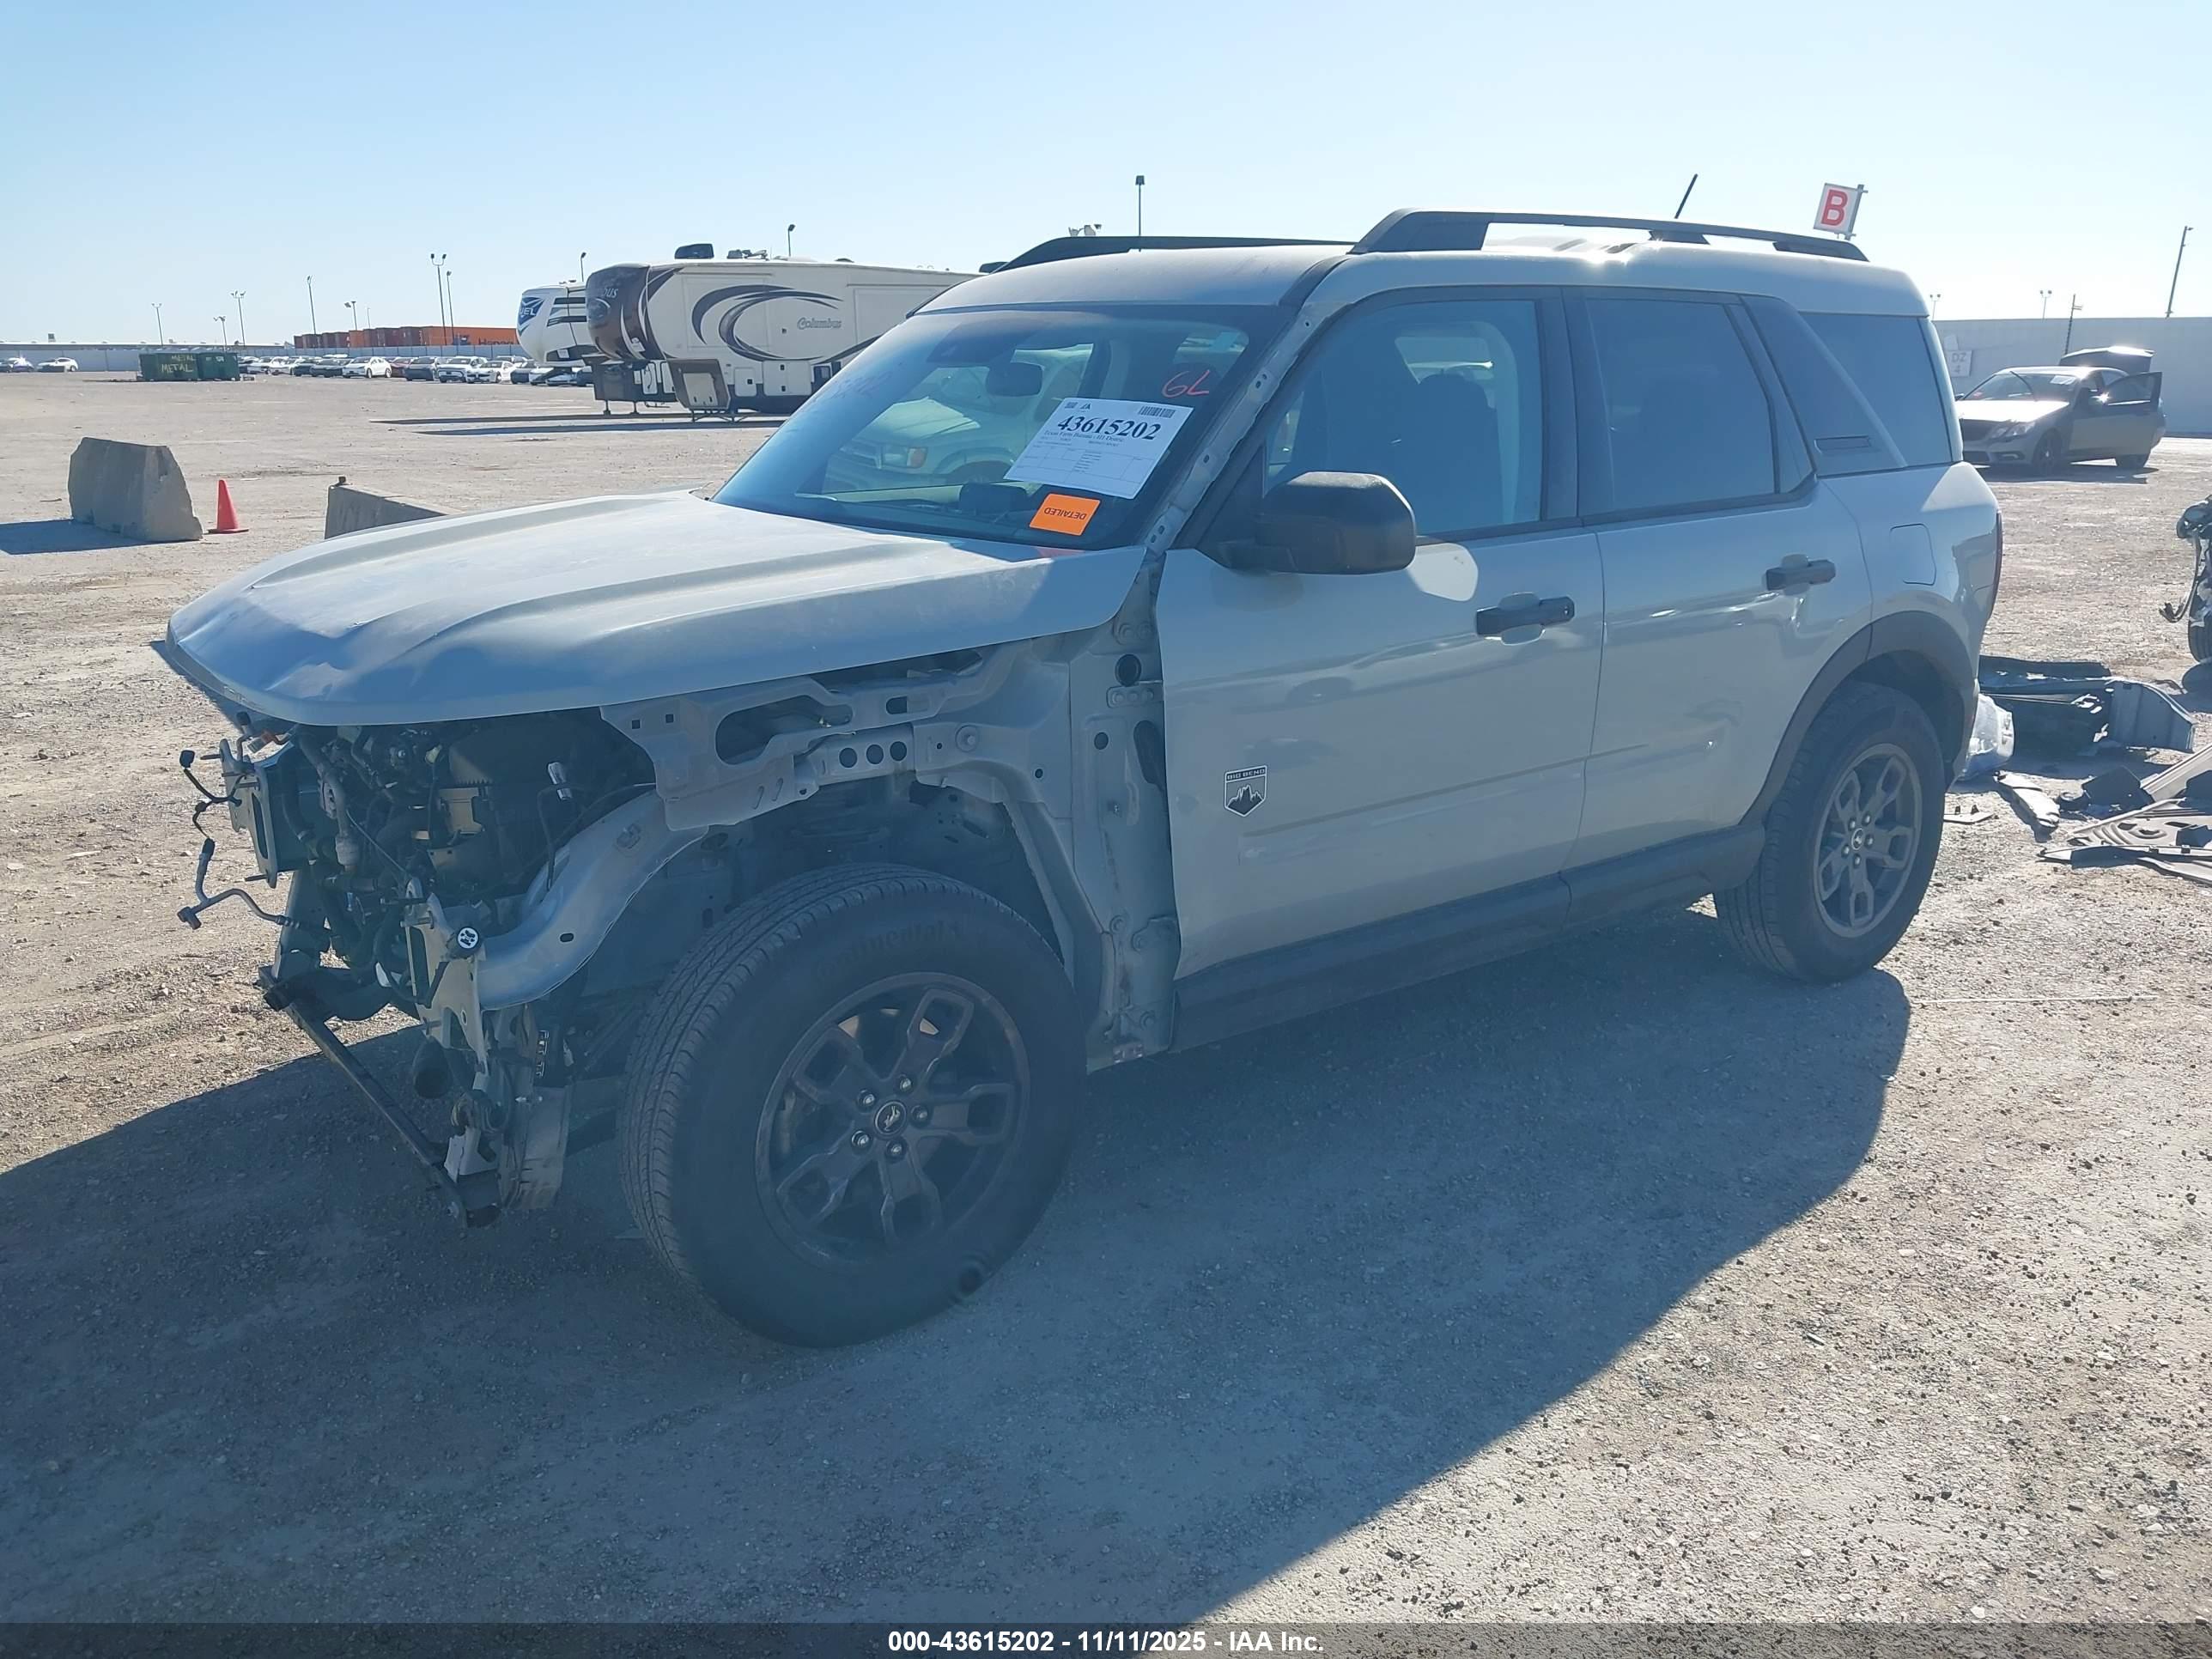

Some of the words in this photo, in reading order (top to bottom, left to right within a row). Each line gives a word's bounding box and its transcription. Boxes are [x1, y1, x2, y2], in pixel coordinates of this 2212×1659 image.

[1820, 189, 1848, 226] B
[797, 317, 842, 330] Columbus
[161, 363, 194, 374] METAL
[1057, 415, 1162, 441] 43615202
[1043, 507, 1087, 520] DETAILED
